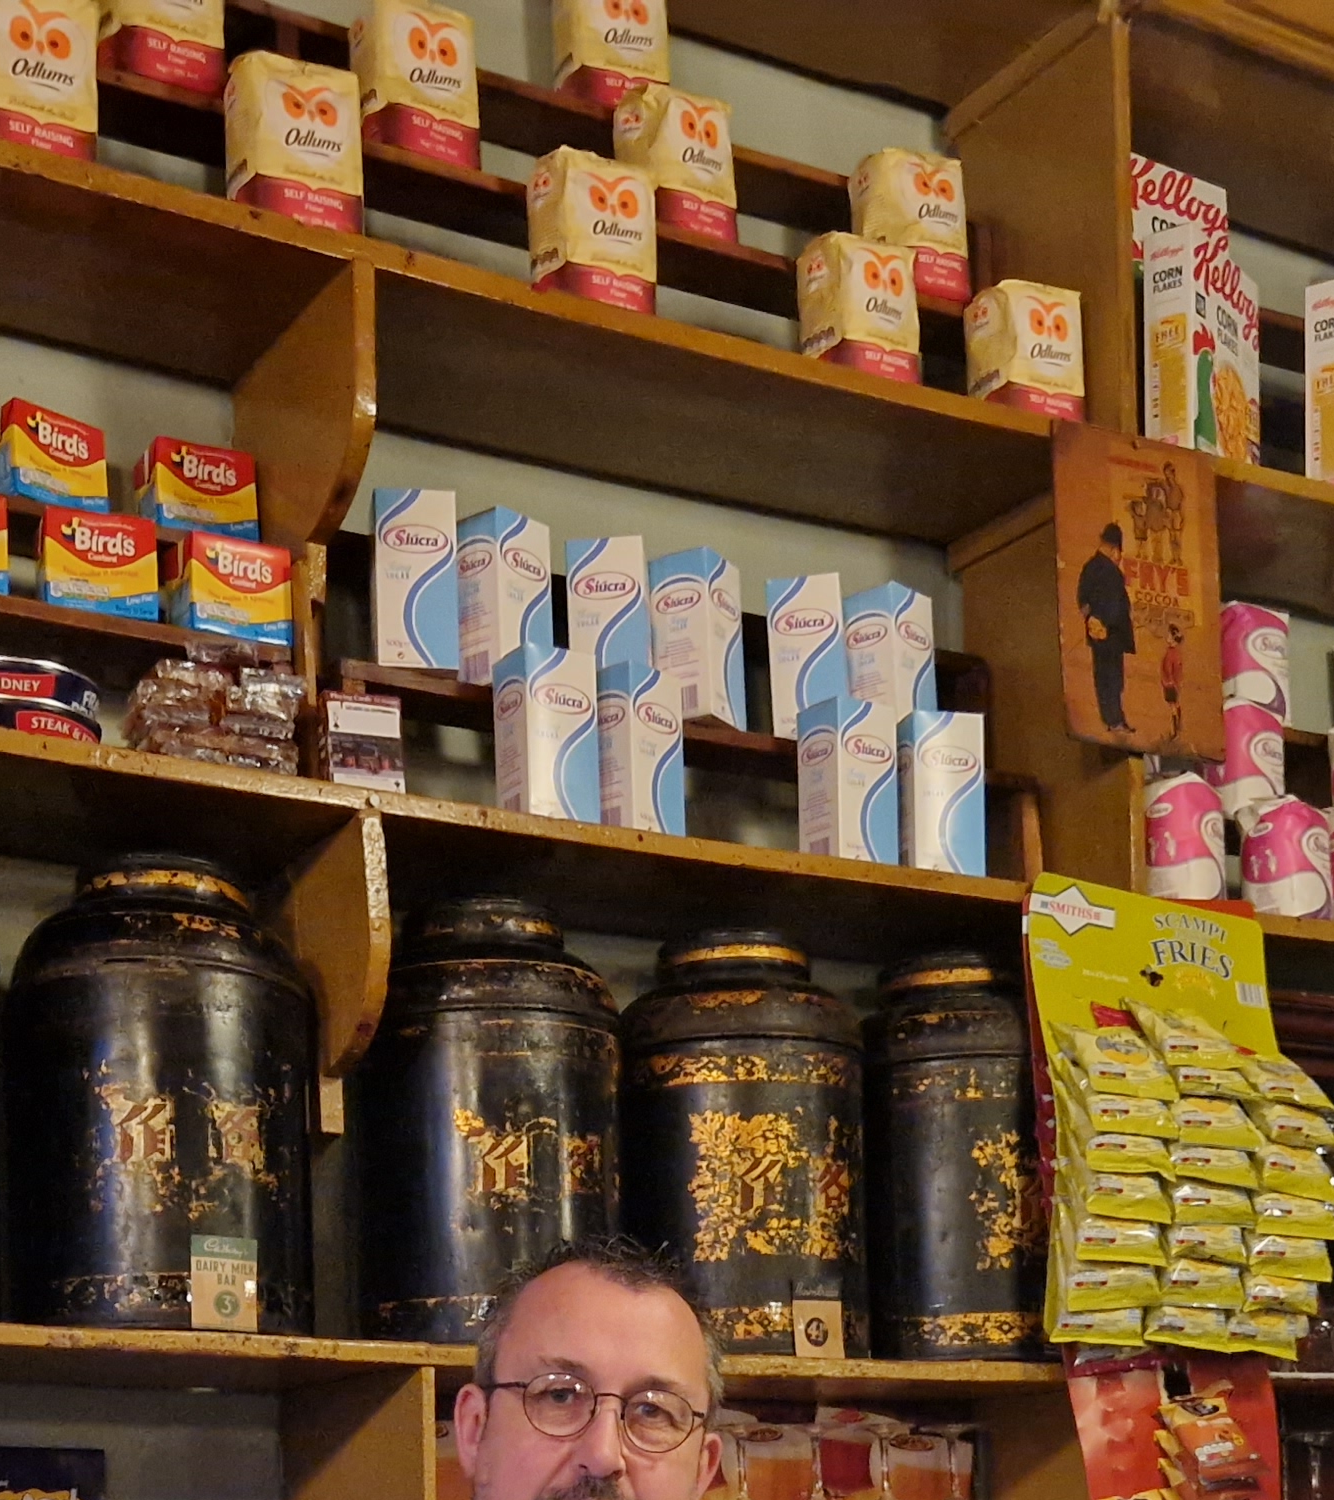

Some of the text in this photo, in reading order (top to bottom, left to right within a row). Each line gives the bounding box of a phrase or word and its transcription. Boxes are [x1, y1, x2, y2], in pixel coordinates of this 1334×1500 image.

[147, 37, 169, 52] SELF
[603, 28, 654, 49] Odlums
[10, 57, 76, 88] Odlums
[410, 67, 463, 90] Odlums
[9, 119, 35, 136] SELF
[412, 115, 435, 130] SELF
[284, 127, 343, 154] Odlums
[681, 146, 724, 174] Odlums
[284, 187, 306, 202] SELF
[918, 203, 959, 223] Odlums
[592, 220, 643, 243] Odlums
[592, 274, 612, 288] SELF
[1152, 265, 1183, 284] CORN
[1152, 278, 1183, 295] FLAKES
[866, 297, 902, 321] Odlums
[1030, 343, 1072, 363] Odlums
[1134, 590, 1180, 608] COCOA
[31, 716, 70, 736] STEAK
[1047, 900, 1094, 921] SMITHS
[1153, 911, 1228, 944] SCAMPI
[1150, 938, 1235, 979] FRIES
[195, 1259, 255, 1276] DAIRY MILK
[216, 1272, 237, 1286] BAR
